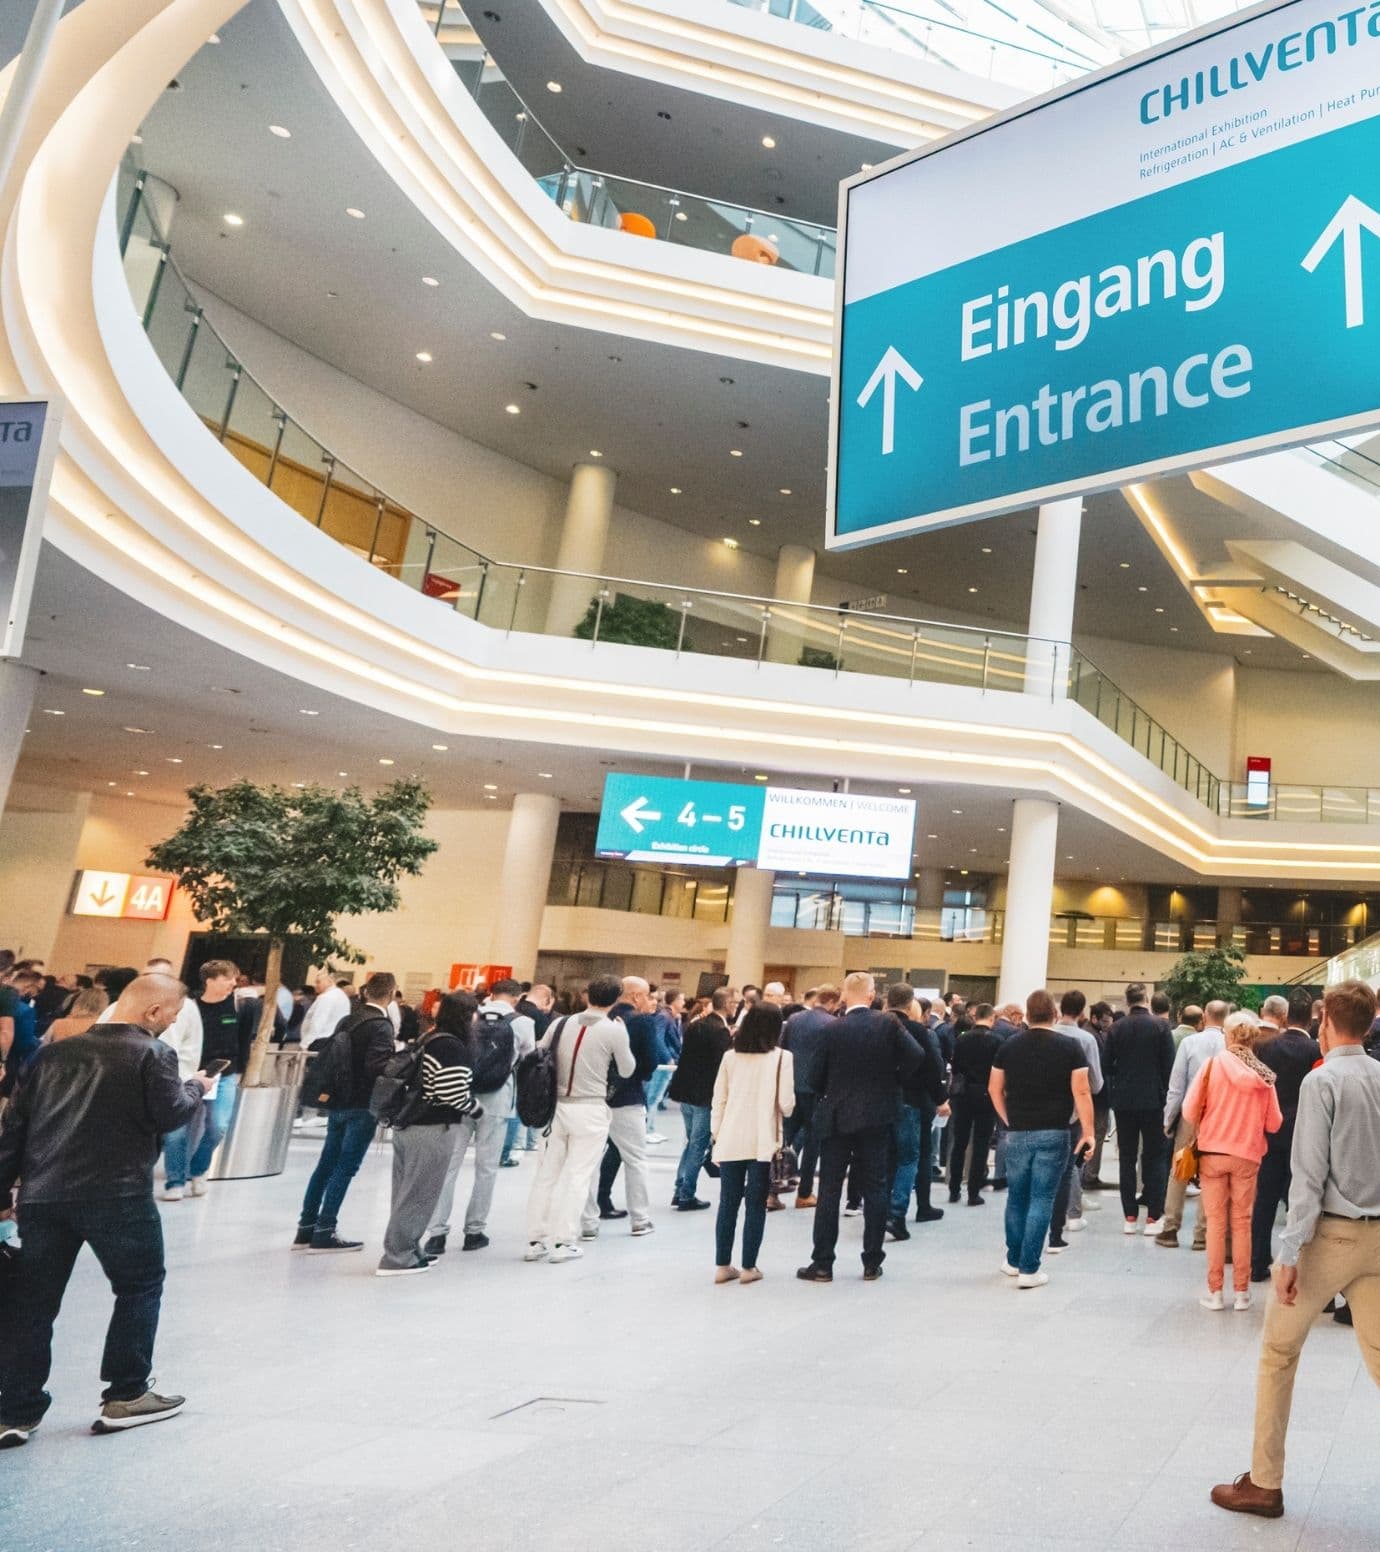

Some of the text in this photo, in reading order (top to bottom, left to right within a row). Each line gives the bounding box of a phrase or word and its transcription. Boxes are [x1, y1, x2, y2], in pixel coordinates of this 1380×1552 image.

[1139, 107, 1268, 163] International Exhibition
[1139, 146, 1209, 180] Refrigeration
[1219, 136, 1236, 151] AC
[1239, 132, 1248, 143] &
[1251, 107, 1315, 140] Ventilation
[1327, 93, 1356, 113] Heat
[960, 231, 1225, 362] Eingang
[958, 344, 1253, 467] Entrance
[769, 793, 847, 809] WILLKOMMEN
[131, 884, 163, 912] 4A
